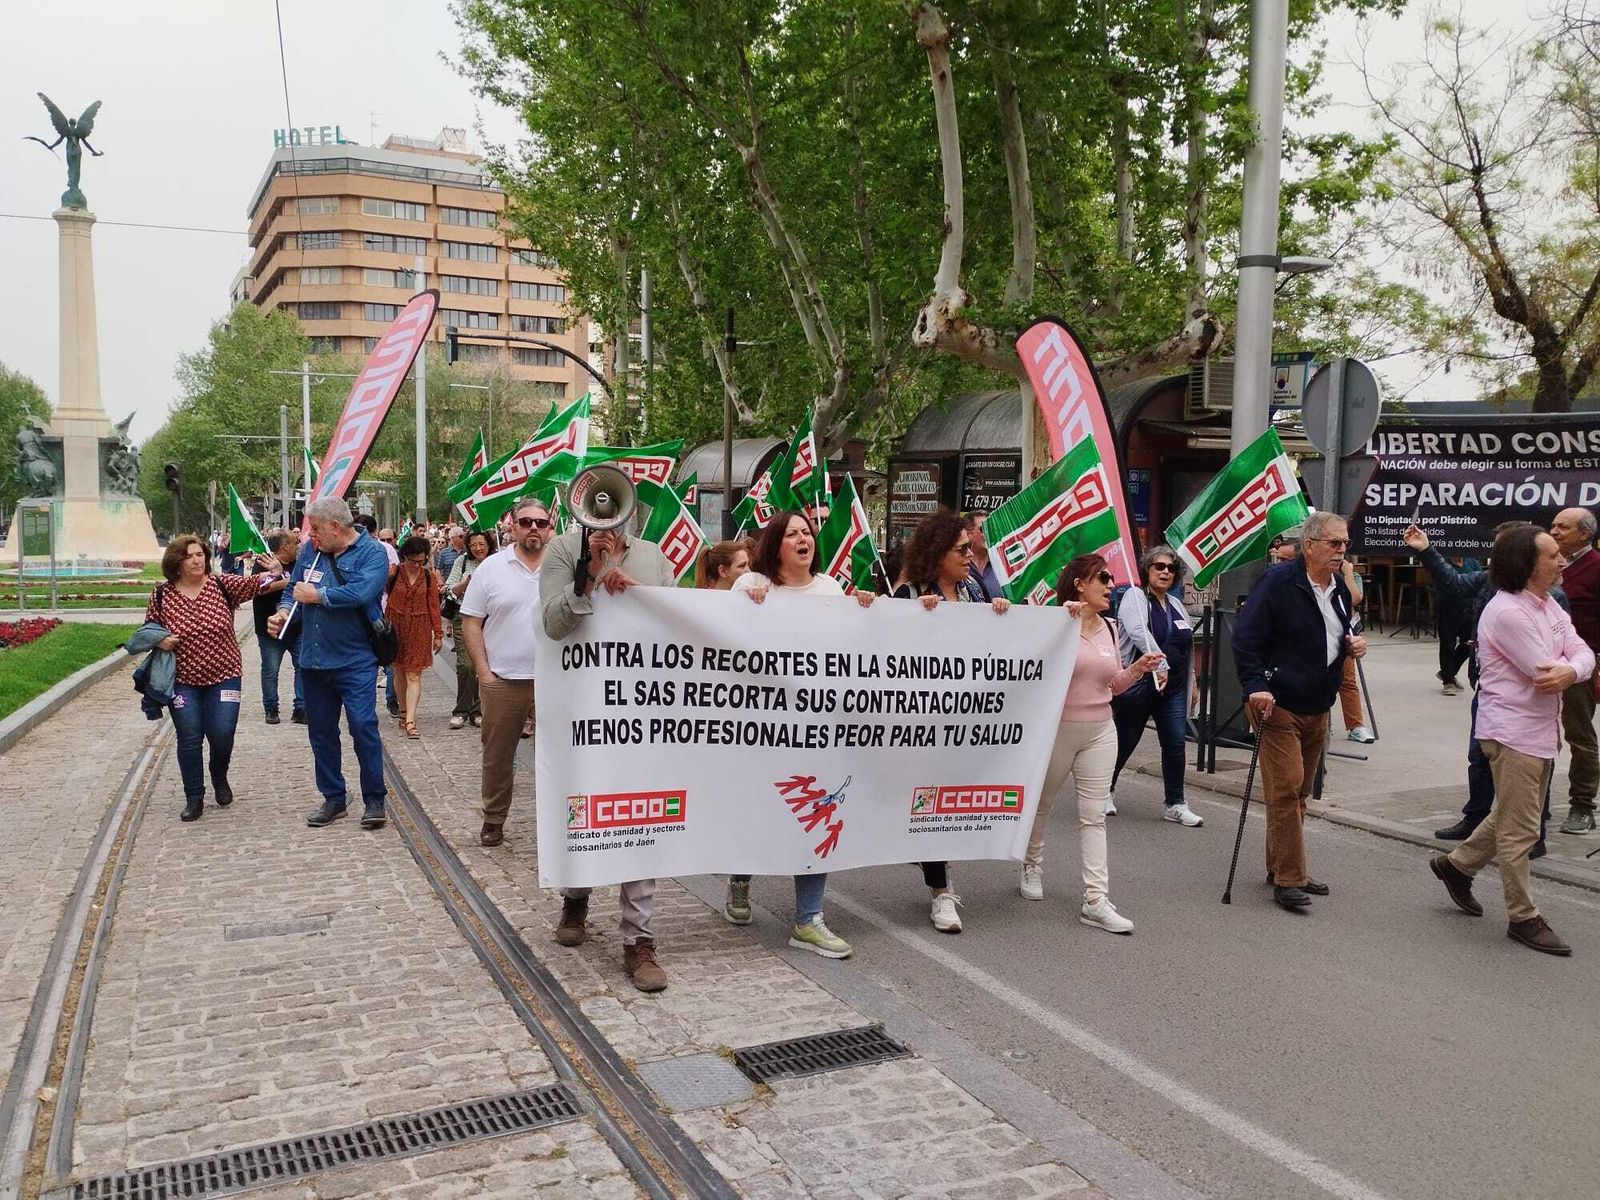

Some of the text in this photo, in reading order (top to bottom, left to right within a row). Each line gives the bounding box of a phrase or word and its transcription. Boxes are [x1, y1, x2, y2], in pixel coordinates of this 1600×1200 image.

[273, 125, 346, 147] HOTEL
[1366, 430, 1600, 455] LIBERTAD CONS
[1380, 457, 1427, 470] NACIÓN
[1429, 459, 1458, 470] debe
[1461, 459, 1495, 472] elegir
[1498, 461, 1512, 470] su
[1515, 459, 1552, 470] forma
[1555, 458, 1571, 469] de
[1365, 475, 1600, 507] SEPARACIÓN D
[974, 494, 989, 508] 679
[1364, 516, 1378, 524] Un
[1422, 517, 1438, 526] por
[1440, 516, 1478, 525] Distrito
[1364, 527, 1377, 535] Sin
[1378, 527, 1398, 536] listas
[1364, 537, 1397, 547] Elección
[1447, 540, 1454, 548] a
[1455, 539, 1480, 548] doble
[562, 641, 1043, 681] CONTRA LOS RECORTES EN LA SANIDAD PÚBLICA
[604, 680, 1005, 714] EL SAS RECORTA SUS CONTRATACIONES
[572, 718, 1023, 749] MENOS PROFESIONALES PEOR PARA TU SALUD
[941, 790, 1002, 809] CCOO
[597, 797, 664, 822] CCOO
[954, 814, 982, 822] sanidad
[983, 815, 988, 823] y
[602, 829, 611, 838] de
[612, 826, 644, 836] sanidad
[645, 826, 651, 834] y
[652, 823, 686, 833] sectores
[908, 824, 962, 834] sociosanitarios
[624, 839, 634, 848] de
[636, 837, 655, 847] Jaén
